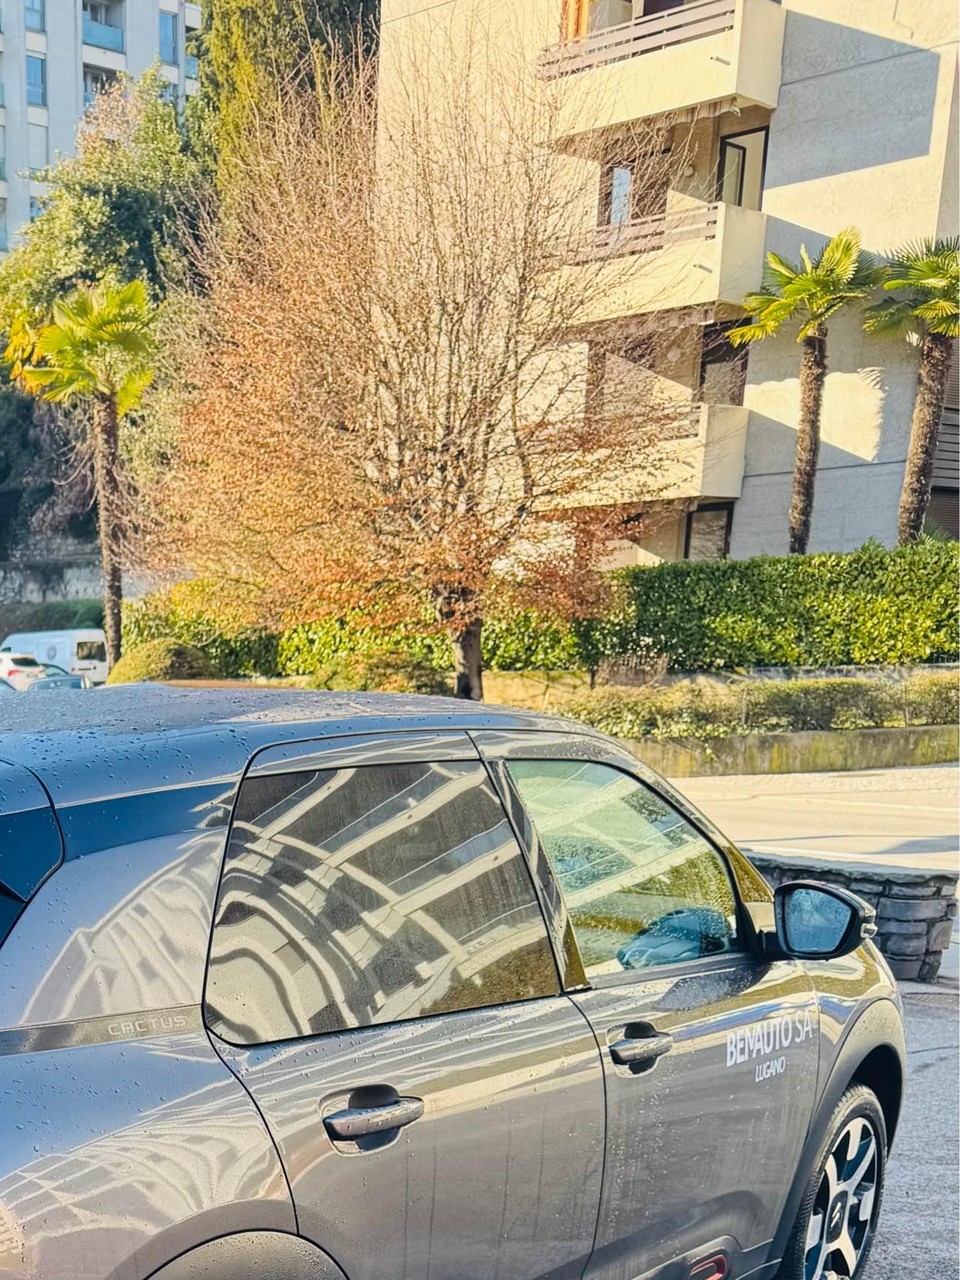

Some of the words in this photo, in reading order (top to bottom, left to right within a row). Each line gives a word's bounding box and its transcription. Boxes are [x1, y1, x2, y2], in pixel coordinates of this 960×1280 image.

[108, 1016, 186, 1035] CACTUS
[726, 1014, 792, 1067] BEMAUTO
[796, 1008, 813, 1042] SA
[755, 1056, 786, 1082] LUGANO
